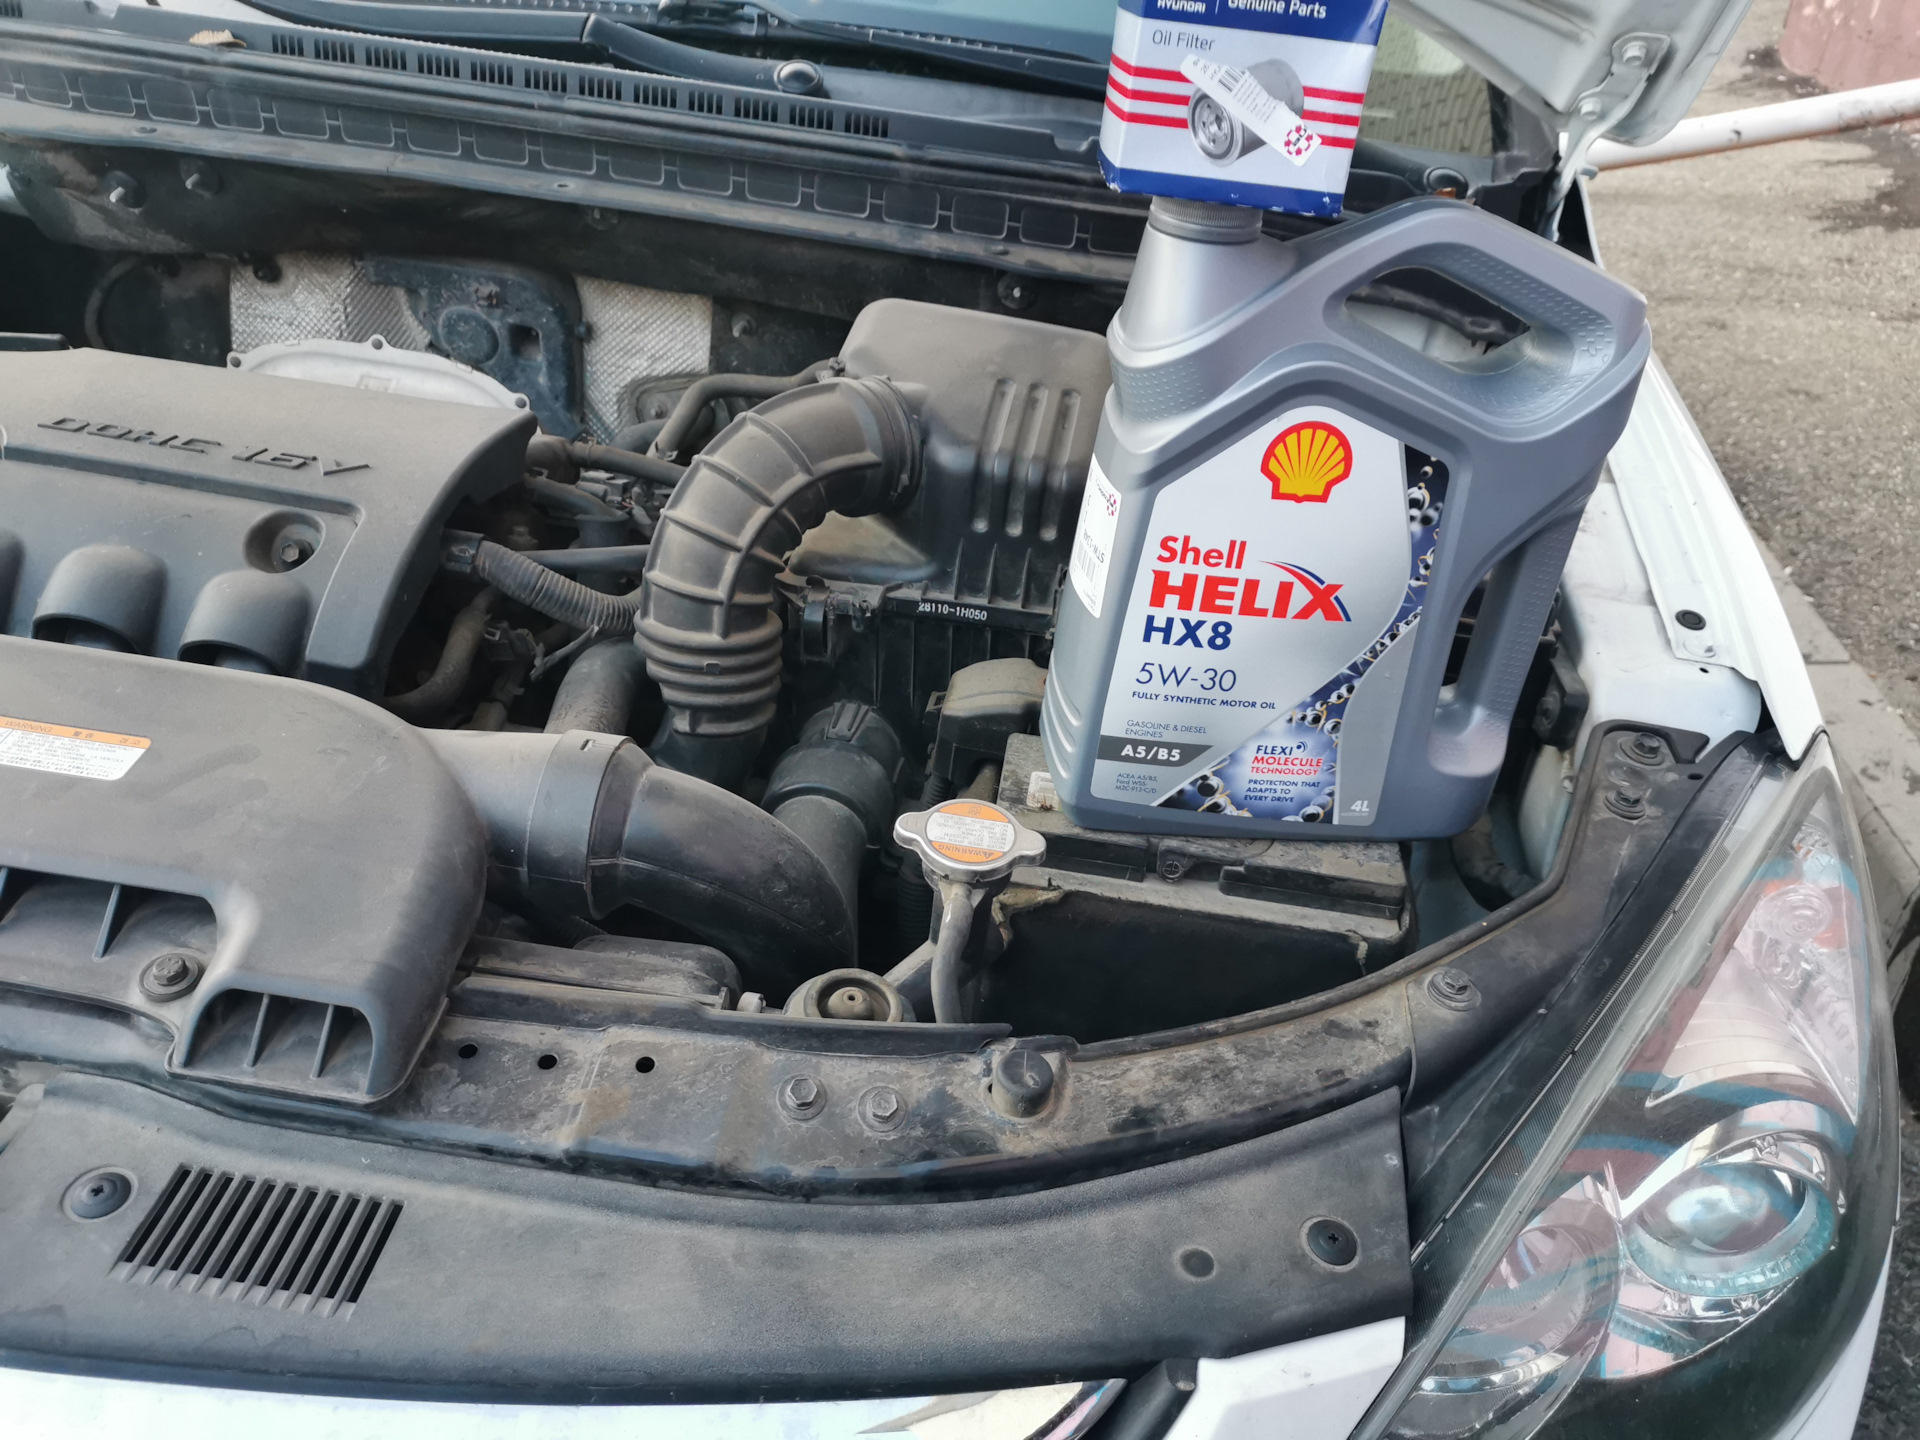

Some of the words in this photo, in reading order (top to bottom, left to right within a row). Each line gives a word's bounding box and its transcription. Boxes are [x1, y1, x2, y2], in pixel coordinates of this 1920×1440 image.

[1228, 0, 1285, 14] Genuine
[1289, 5, 1327, 19] Parts
[1152, 29, 1172, 46] Oil
[1176, 32, 1216, 51] Filter
[37, 417, 222, 455] DOHC
[232, 447, 371, 477] 16V
[1156, 535, 1247, 570] Shell
[1149, 560, 1352, 622] HELIX
[918, 602, 988, 620] 28110-1H050
[1142, 614, 1233, 651] HX8
[1135, 662, 1237, 692] 5W-30
[1132, 691, 1160, 701] FULLY
[1163, 694, 1217, 706] SYNTHETIC
[1219, 699, 1257, 709] MOTOR
[1260, 702, 1276, 710] OIL
[4, 719, 54, 733] WARNING
[1125, 728, 1164, 738] ENGINES
[1127, 720, 1171, 731] GASOLINE
[1180, 725, 1207, 734] DIESEL
[1120, 744, 1181, 762] A5/B5
[1256, 745, 1293, 756] FLEXI
[1250, 766, 1319, 776] TECHNOLOGY
[1252, 756, 1323, 768] MOLECULE
[1248, 779, 1298, 787] PROTECTION
[1350, 800, 1370, 812] 4L
[938, 844, 983, 856] WARNING
